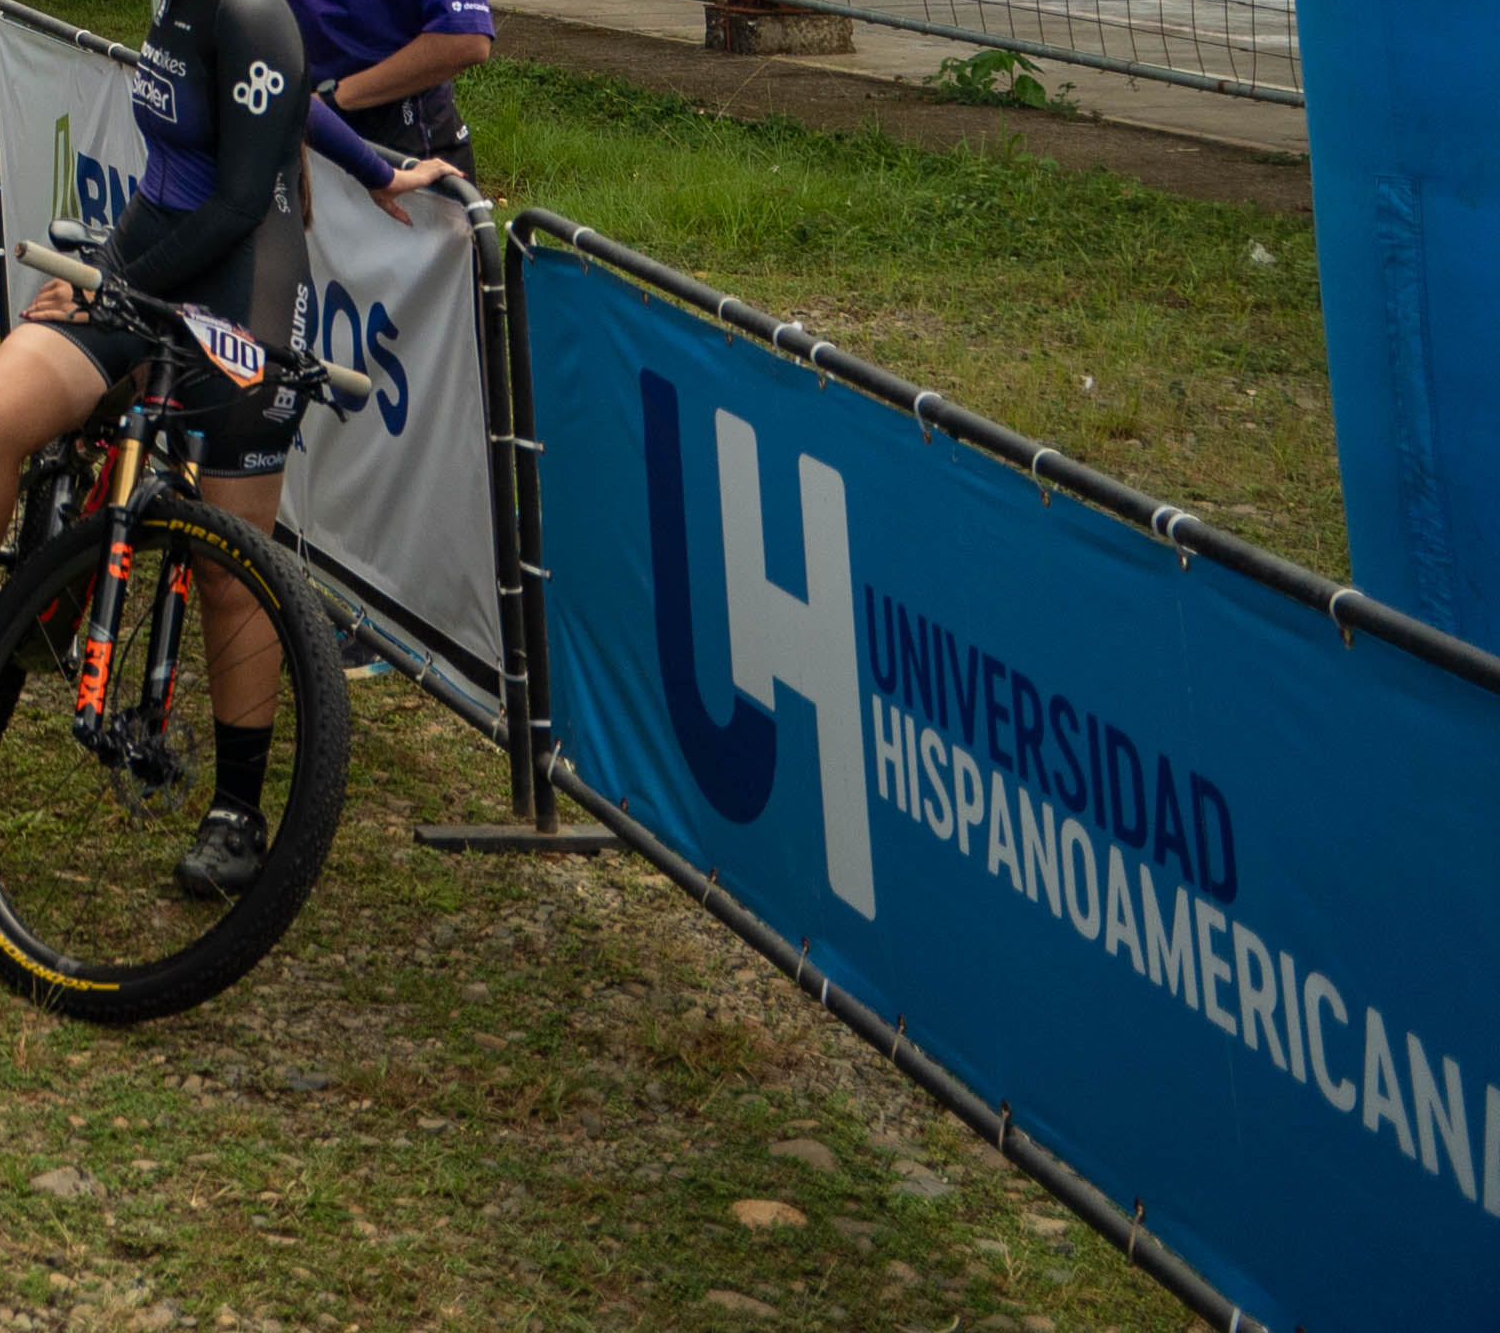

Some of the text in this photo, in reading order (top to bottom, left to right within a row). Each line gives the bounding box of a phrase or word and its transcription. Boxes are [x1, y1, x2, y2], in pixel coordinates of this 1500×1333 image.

[206, 325, 258, 373] 100
[167, 518, 253, 568] PIRELLI
[77, 637, 113, 715] FOX
[864, 584, 1239, 903] UNIVERSIDAD
[871, 693, 1500, 1216] HISPANOAMERICAN
